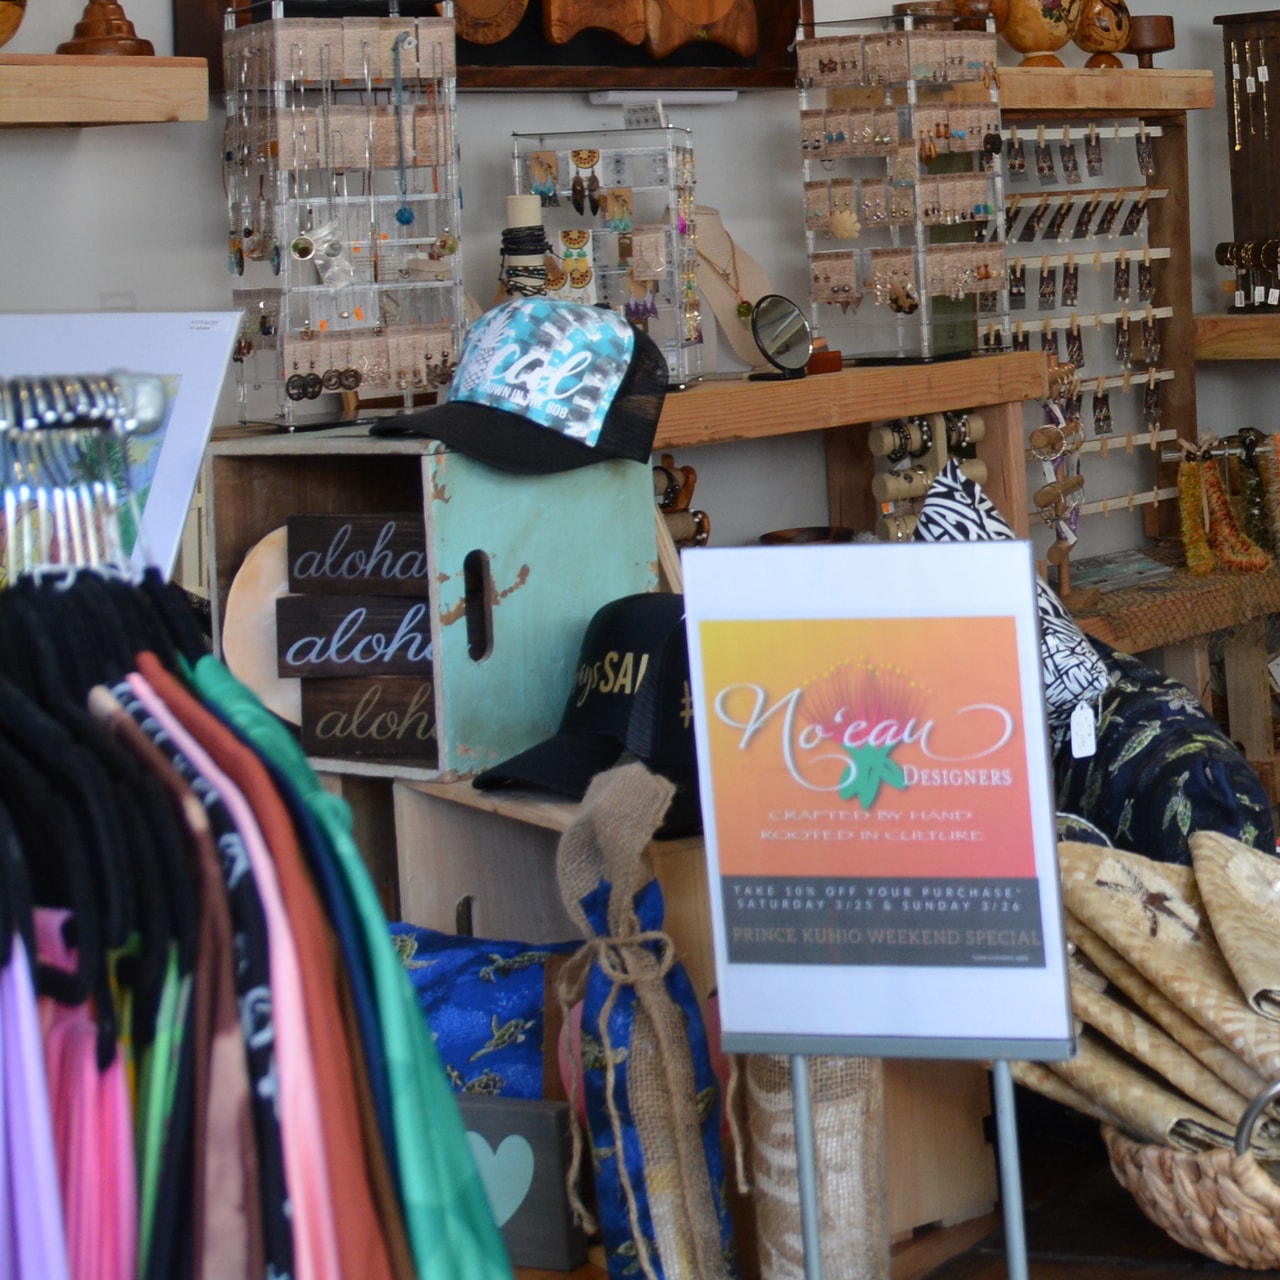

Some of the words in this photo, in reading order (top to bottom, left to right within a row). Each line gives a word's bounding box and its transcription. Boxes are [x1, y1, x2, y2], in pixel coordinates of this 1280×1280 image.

[546, 402, 568, 419] 808
[293, 520, 428, 580] aloha
[285, 603, 433, 666] aloh
[314, 683, 437, 741] aloh
[901, 763, 1013, 787] DESIGNERS
[767, 809, 871, 821] CRAFTED
[876, 809, 903, 821] BY
[910, 809, 974, 821] HAND
[759, 829, 854, 841] ROOTED
[860, 829, 879, 841] IN
[884, 829, 985, 842] CULTURE
[732, 885, 776, 898] TAKE
[785, 886, 816, 898] 10%
[825, 886, 857, 898] OFF
[866, 886, 912, 898] YOUR
[736, 898, 826, 911] SATURDAY
[836, 898, 874, 911] 3/25
[882, 899, 892, 911] &
[901, 899, 971, 912] SUNDAY
[980, 899, 1022, 913] 3/26
[732, 925, 797, 943] PRINCE
[801, 926, 861, 945] KUHIO
[866, 928, 960, 946] WEEKEND
[965, 929, 1042, 947] SPECIAL
